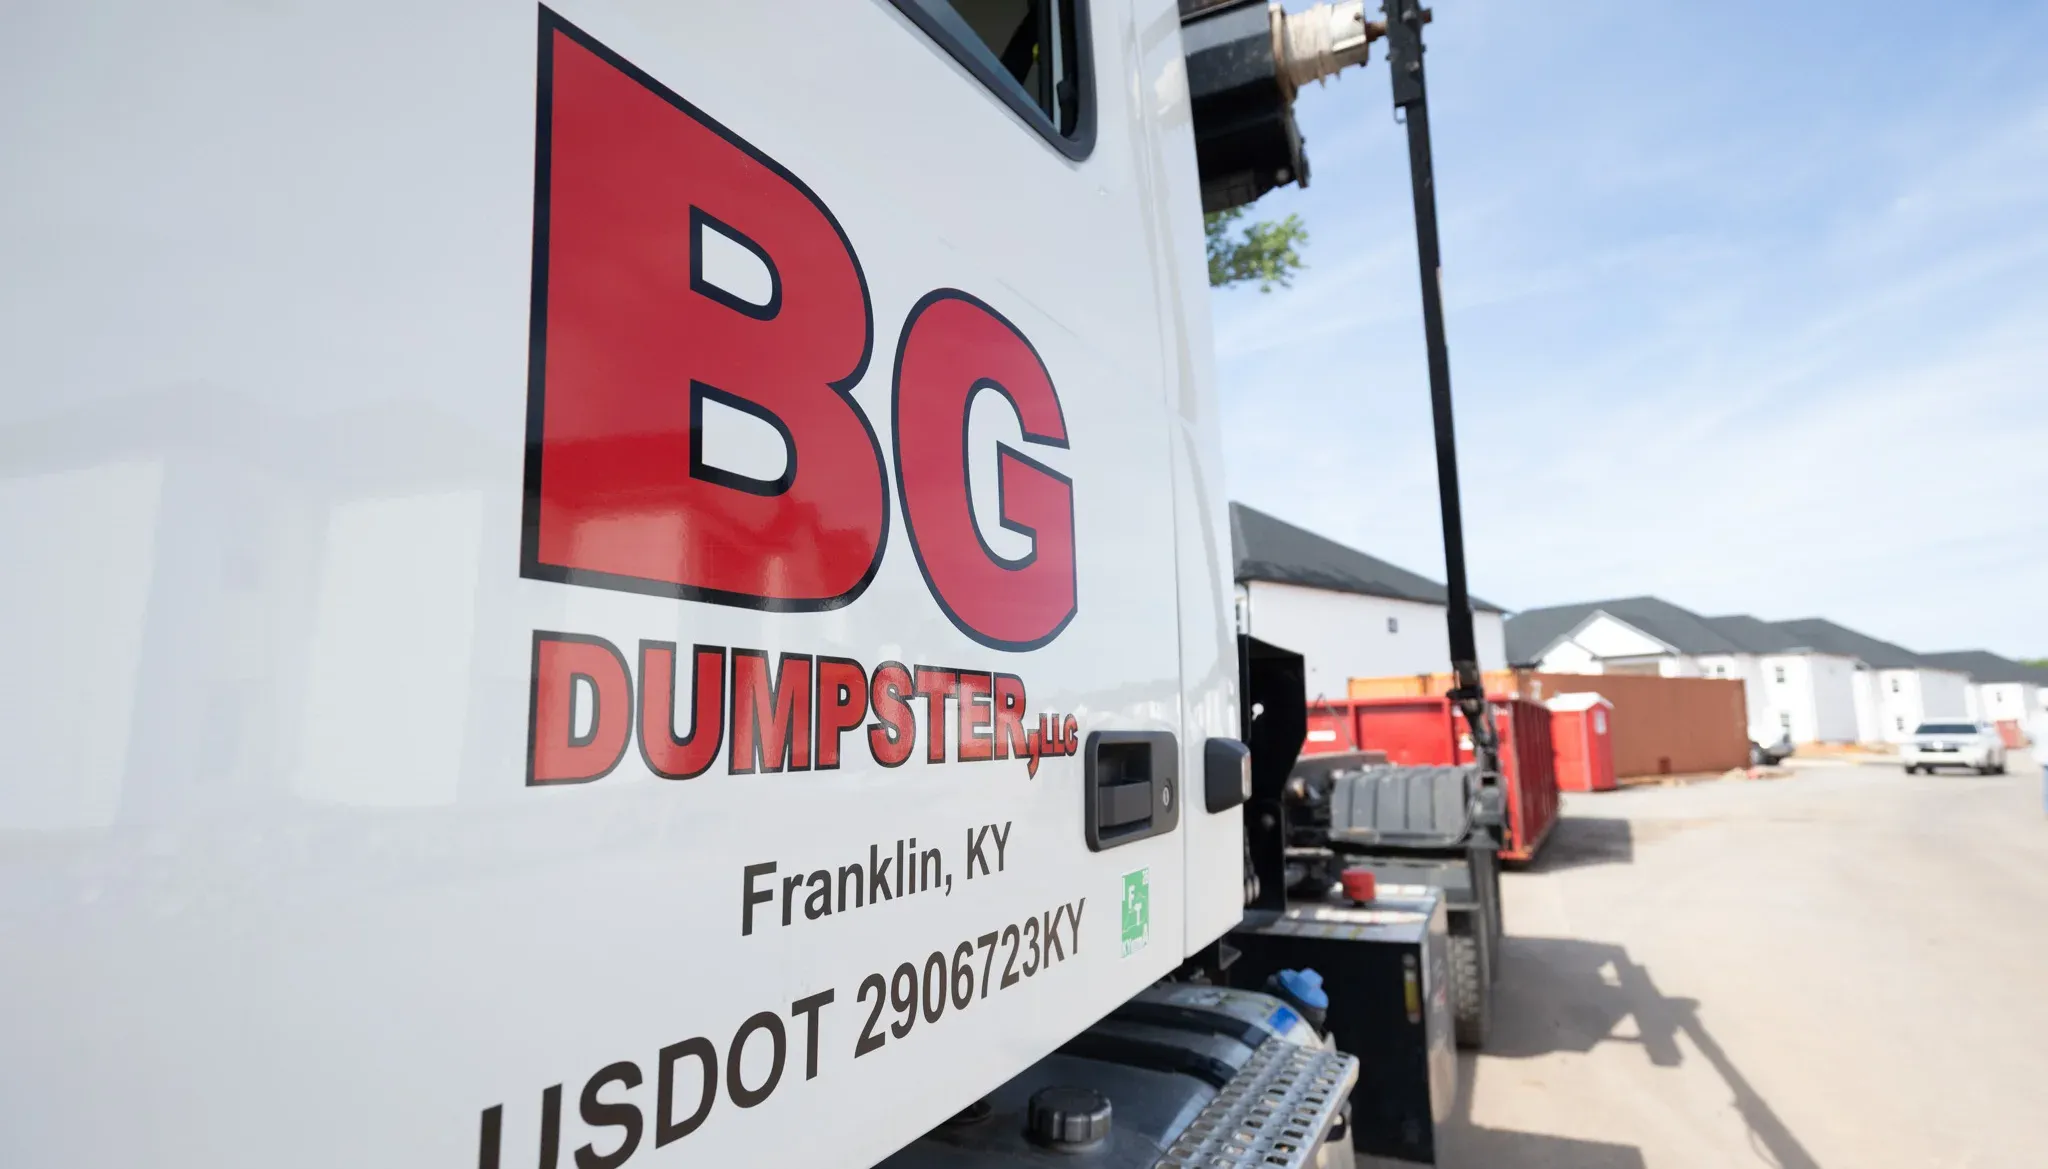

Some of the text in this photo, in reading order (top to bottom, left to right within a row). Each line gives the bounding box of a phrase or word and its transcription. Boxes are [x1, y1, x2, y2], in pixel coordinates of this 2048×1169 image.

[519, 3, 1078, 653] BG
[742, 821, 1012, 937] Franklin, KY
[854, 897, 1086, 1059] 2906723KY
